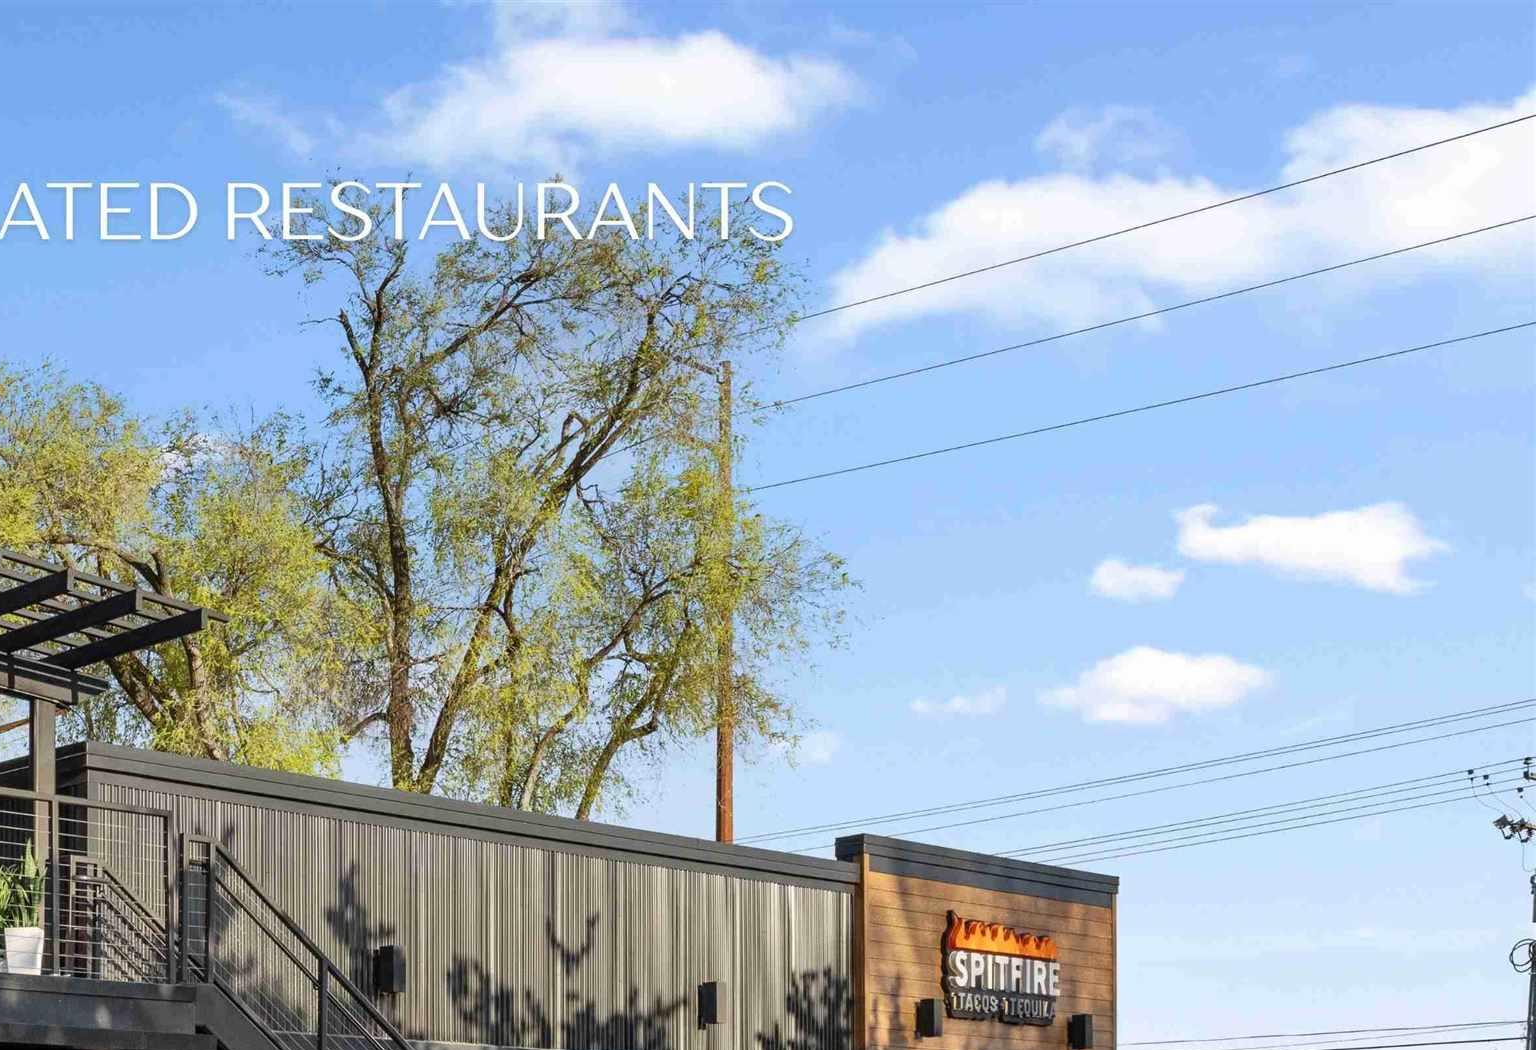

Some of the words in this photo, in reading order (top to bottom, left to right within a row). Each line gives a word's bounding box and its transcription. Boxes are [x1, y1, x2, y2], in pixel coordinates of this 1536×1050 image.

[950, 950, 1061, 996] SPITFIRE
[957, 991, 999, 1013] TACOS
[1009, 997, 1056, 1020] TEQUILA
